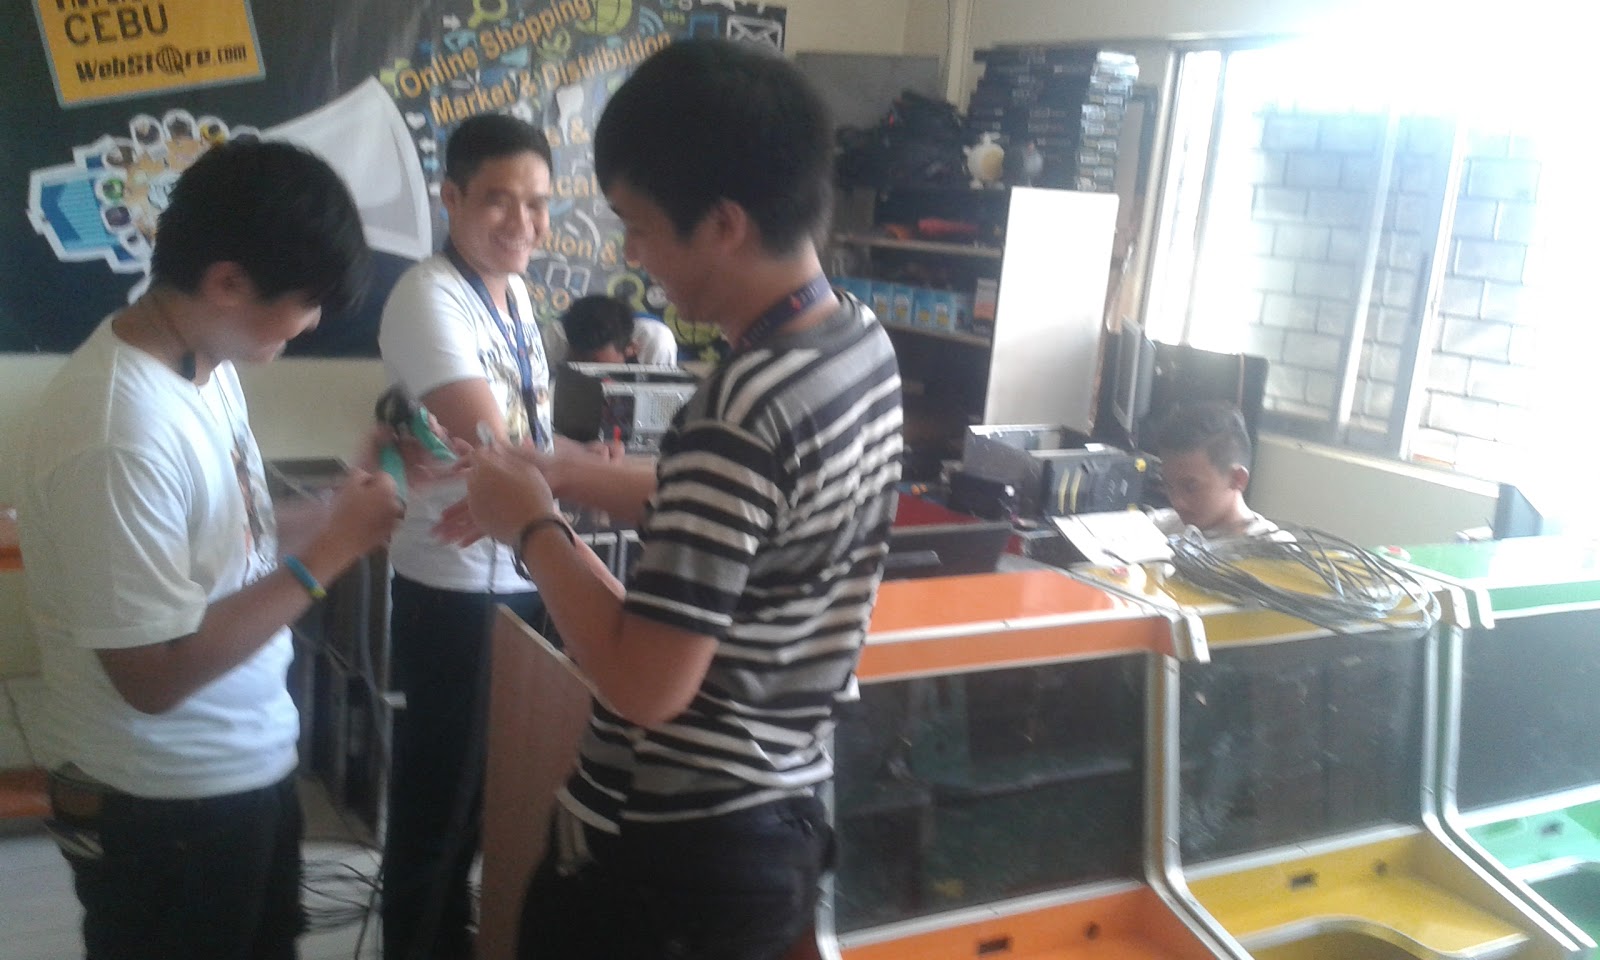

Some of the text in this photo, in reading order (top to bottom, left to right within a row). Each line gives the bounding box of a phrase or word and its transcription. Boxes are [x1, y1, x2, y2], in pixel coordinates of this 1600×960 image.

[64, 3, 168, 46] CEBU
[400, 0, 592, 99] Online Shopping
[430, 78, 516, 126] Market
[542, 32, 671, 91] Distribution
